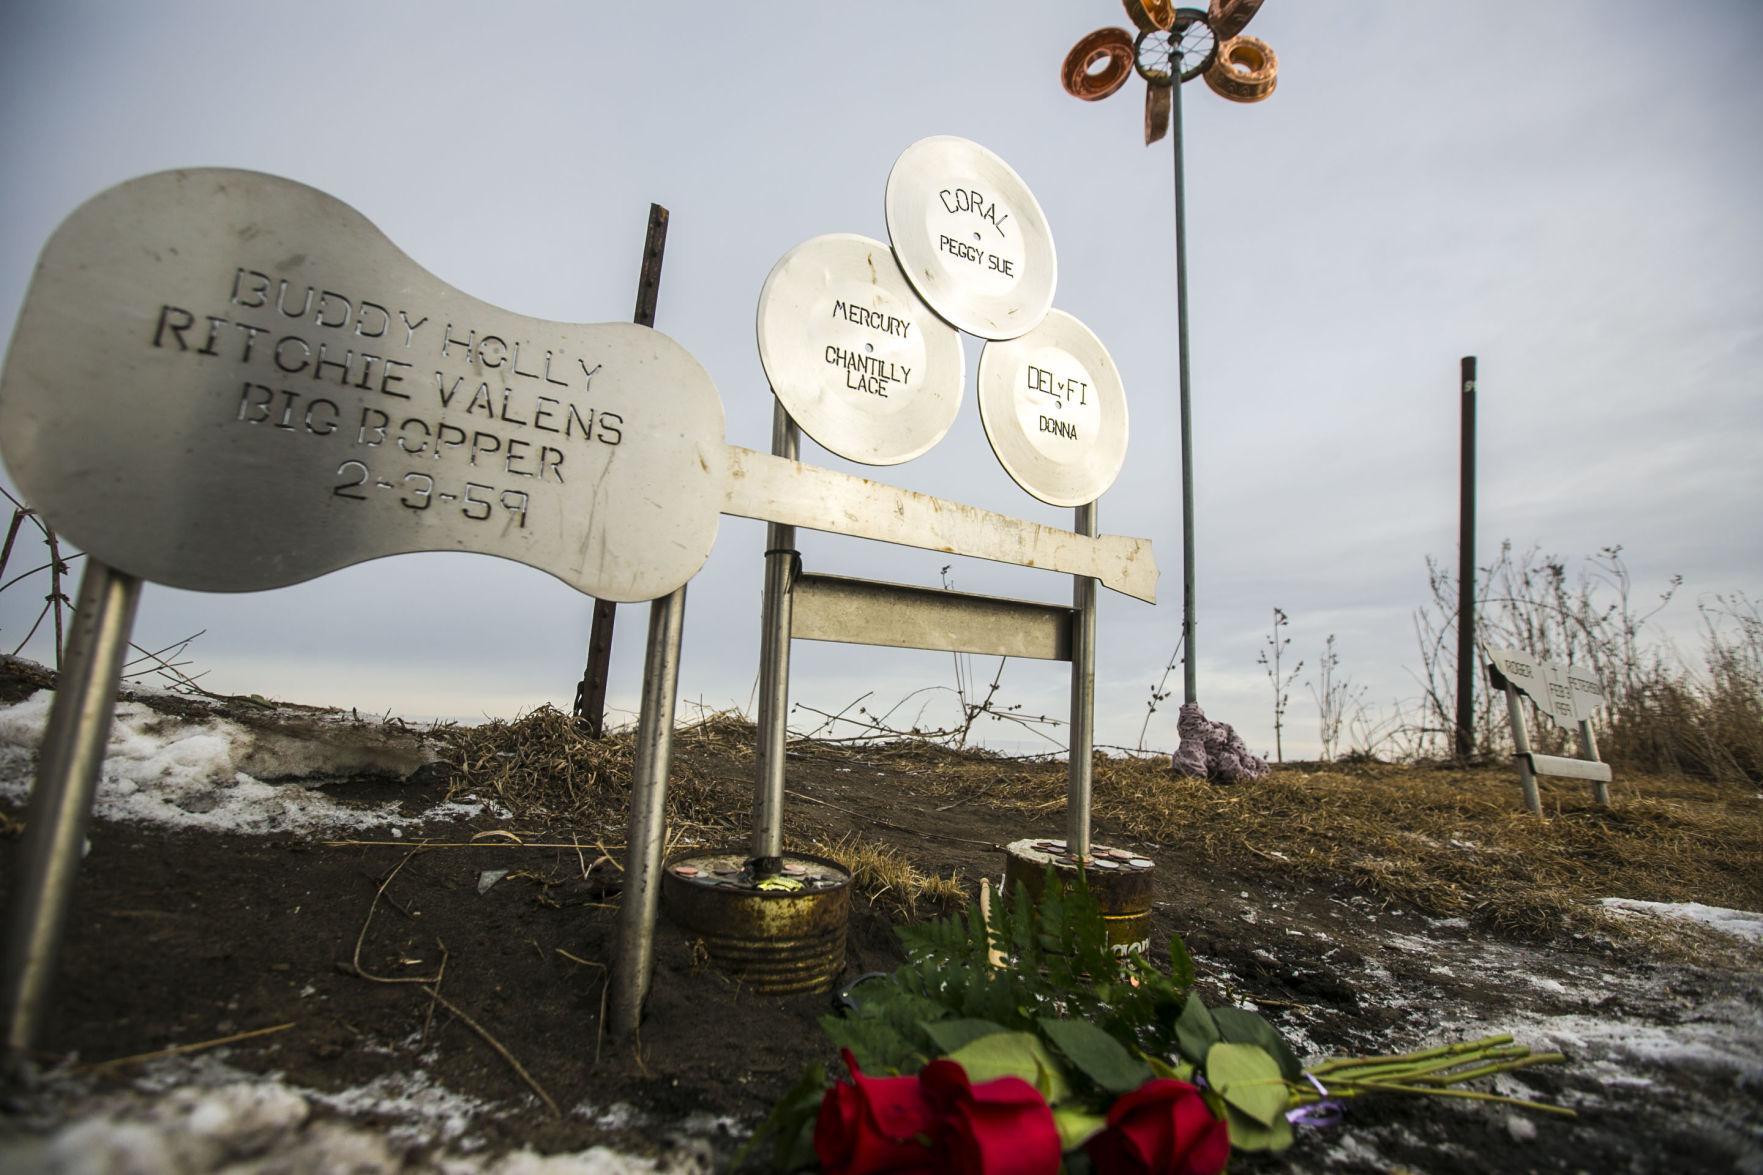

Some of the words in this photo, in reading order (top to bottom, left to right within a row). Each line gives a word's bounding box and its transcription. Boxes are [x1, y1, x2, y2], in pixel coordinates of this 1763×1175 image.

[939, 188, 1008, 238] CORAL
[939, 234, 984, 265] PEGGY
[988, 254, 1014, 279] SUE
[229, 267, 428, 349] BUDDY
[441, 323, 602, 392] HOLLY
[832, 299, 911, 339] MERCURY
[151, 304, 413, 400] RITCHIE
[435, 371, 624, 446] VALENS
[825, 345, 911, 385] CHANTILLY
[846, 369, 888, 399] LACE
[236, 382, 341, 437] BIG
[357, 406, 565, 484] BOPPER
[1039, 415, 1078, 440] DONNA
[331, 459, 530, 529] 2-3-59
